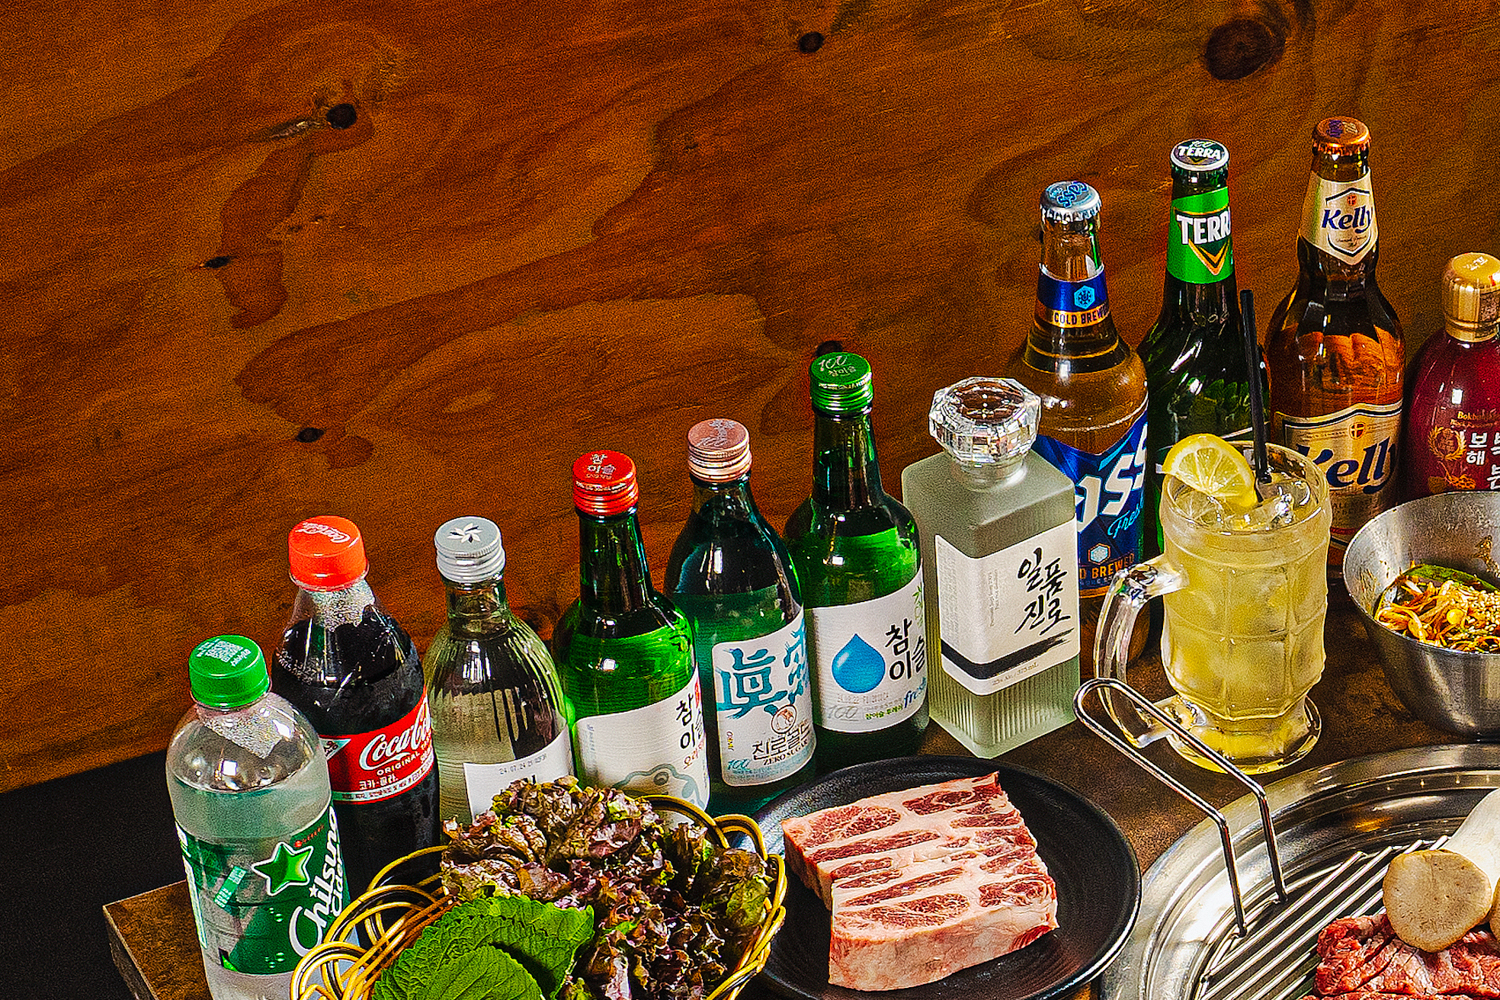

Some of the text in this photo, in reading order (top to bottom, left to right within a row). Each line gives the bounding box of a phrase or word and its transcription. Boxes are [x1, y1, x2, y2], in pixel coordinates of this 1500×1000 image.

[1178, 146, 1221, 160] TERRA
[1321, 205, 1372, 233] Kelly
[1054, 312, 1077, 325] COLD
[1466, 432, 1488, 465] 보해
[1018, 547, 1068, 601] 일품
[1092, 553, 1135, 579] BREWED
[1014, 594, 1071, 636] 진로
[377, 750, 420, 776] ORIGINAL
